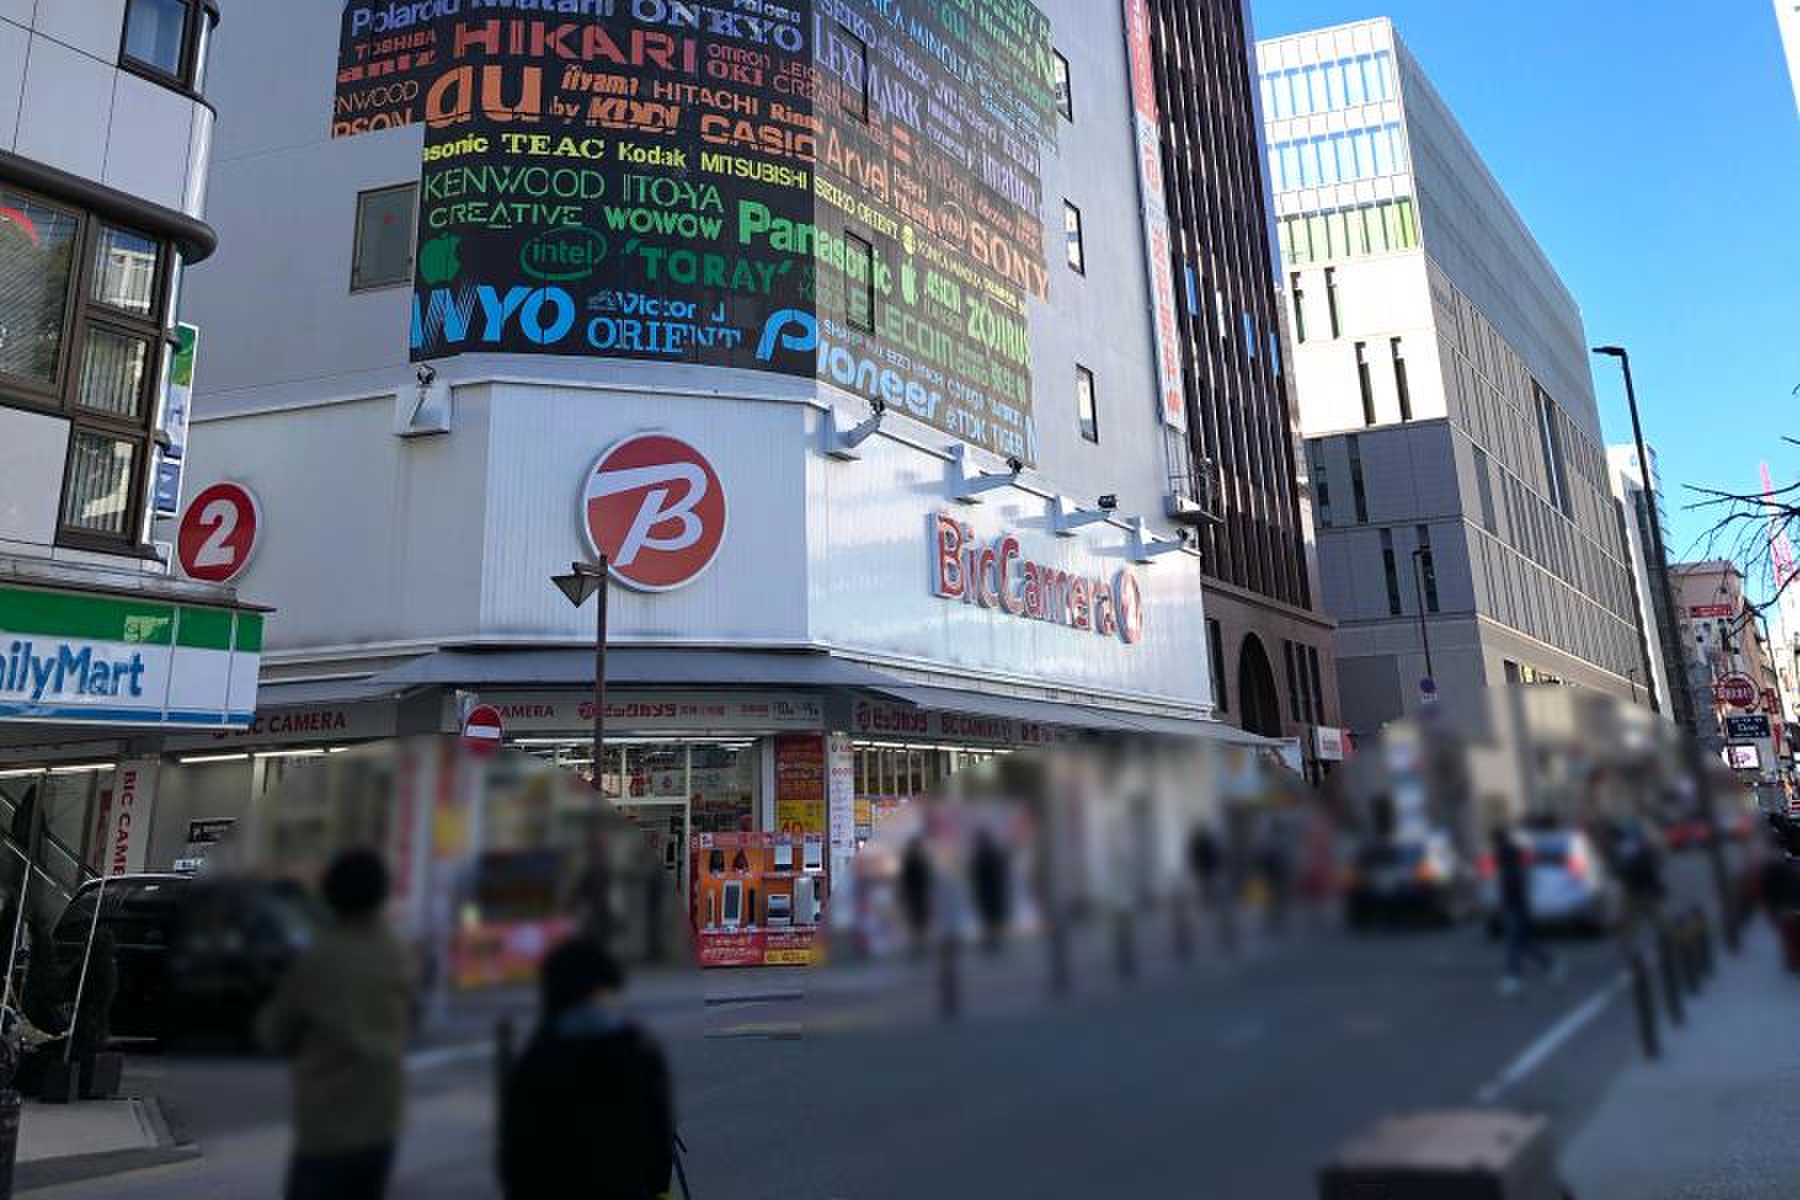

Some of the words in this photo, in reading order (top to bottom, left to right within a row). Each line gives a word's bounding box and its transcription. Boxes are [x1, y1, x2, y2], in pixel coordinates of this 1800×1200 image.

[453, 16, 698, 76] HIKARI
[706, 59, 764, 88] OKI
[425, 64, 543, 130] au
[652, 79, 759, 116] HITACHI
[501, 133, 605, 161] TEAC
[617, 141, 688, 169] Kodak
[700, 151, 808, 192] MITSUBISHI
[701, 114, 817, 162] CASIO
[423, 165, 607, 201] KENWOOD
[428, 201, 585, 230] CREATIVE
[603, 205, 725, 241] WOWOW
[738, 198, 893, 297] Panasonic
[530, 236, 594, 268] intel
[970, 217, 1047, 302] SONY
[587, 316, 743, 355] ORIENT
[623, 289, 698, 319] Victor
[755, 308, 942, 420] Pioneer
[193, 498, 240, 568] 2
[936, 511, 1117, 637] BicCamera
[0, 640, 145, 701] ilyMart
[268, 709, 346, 734] CAMERA
[120, 768, 138, 807] BIC
